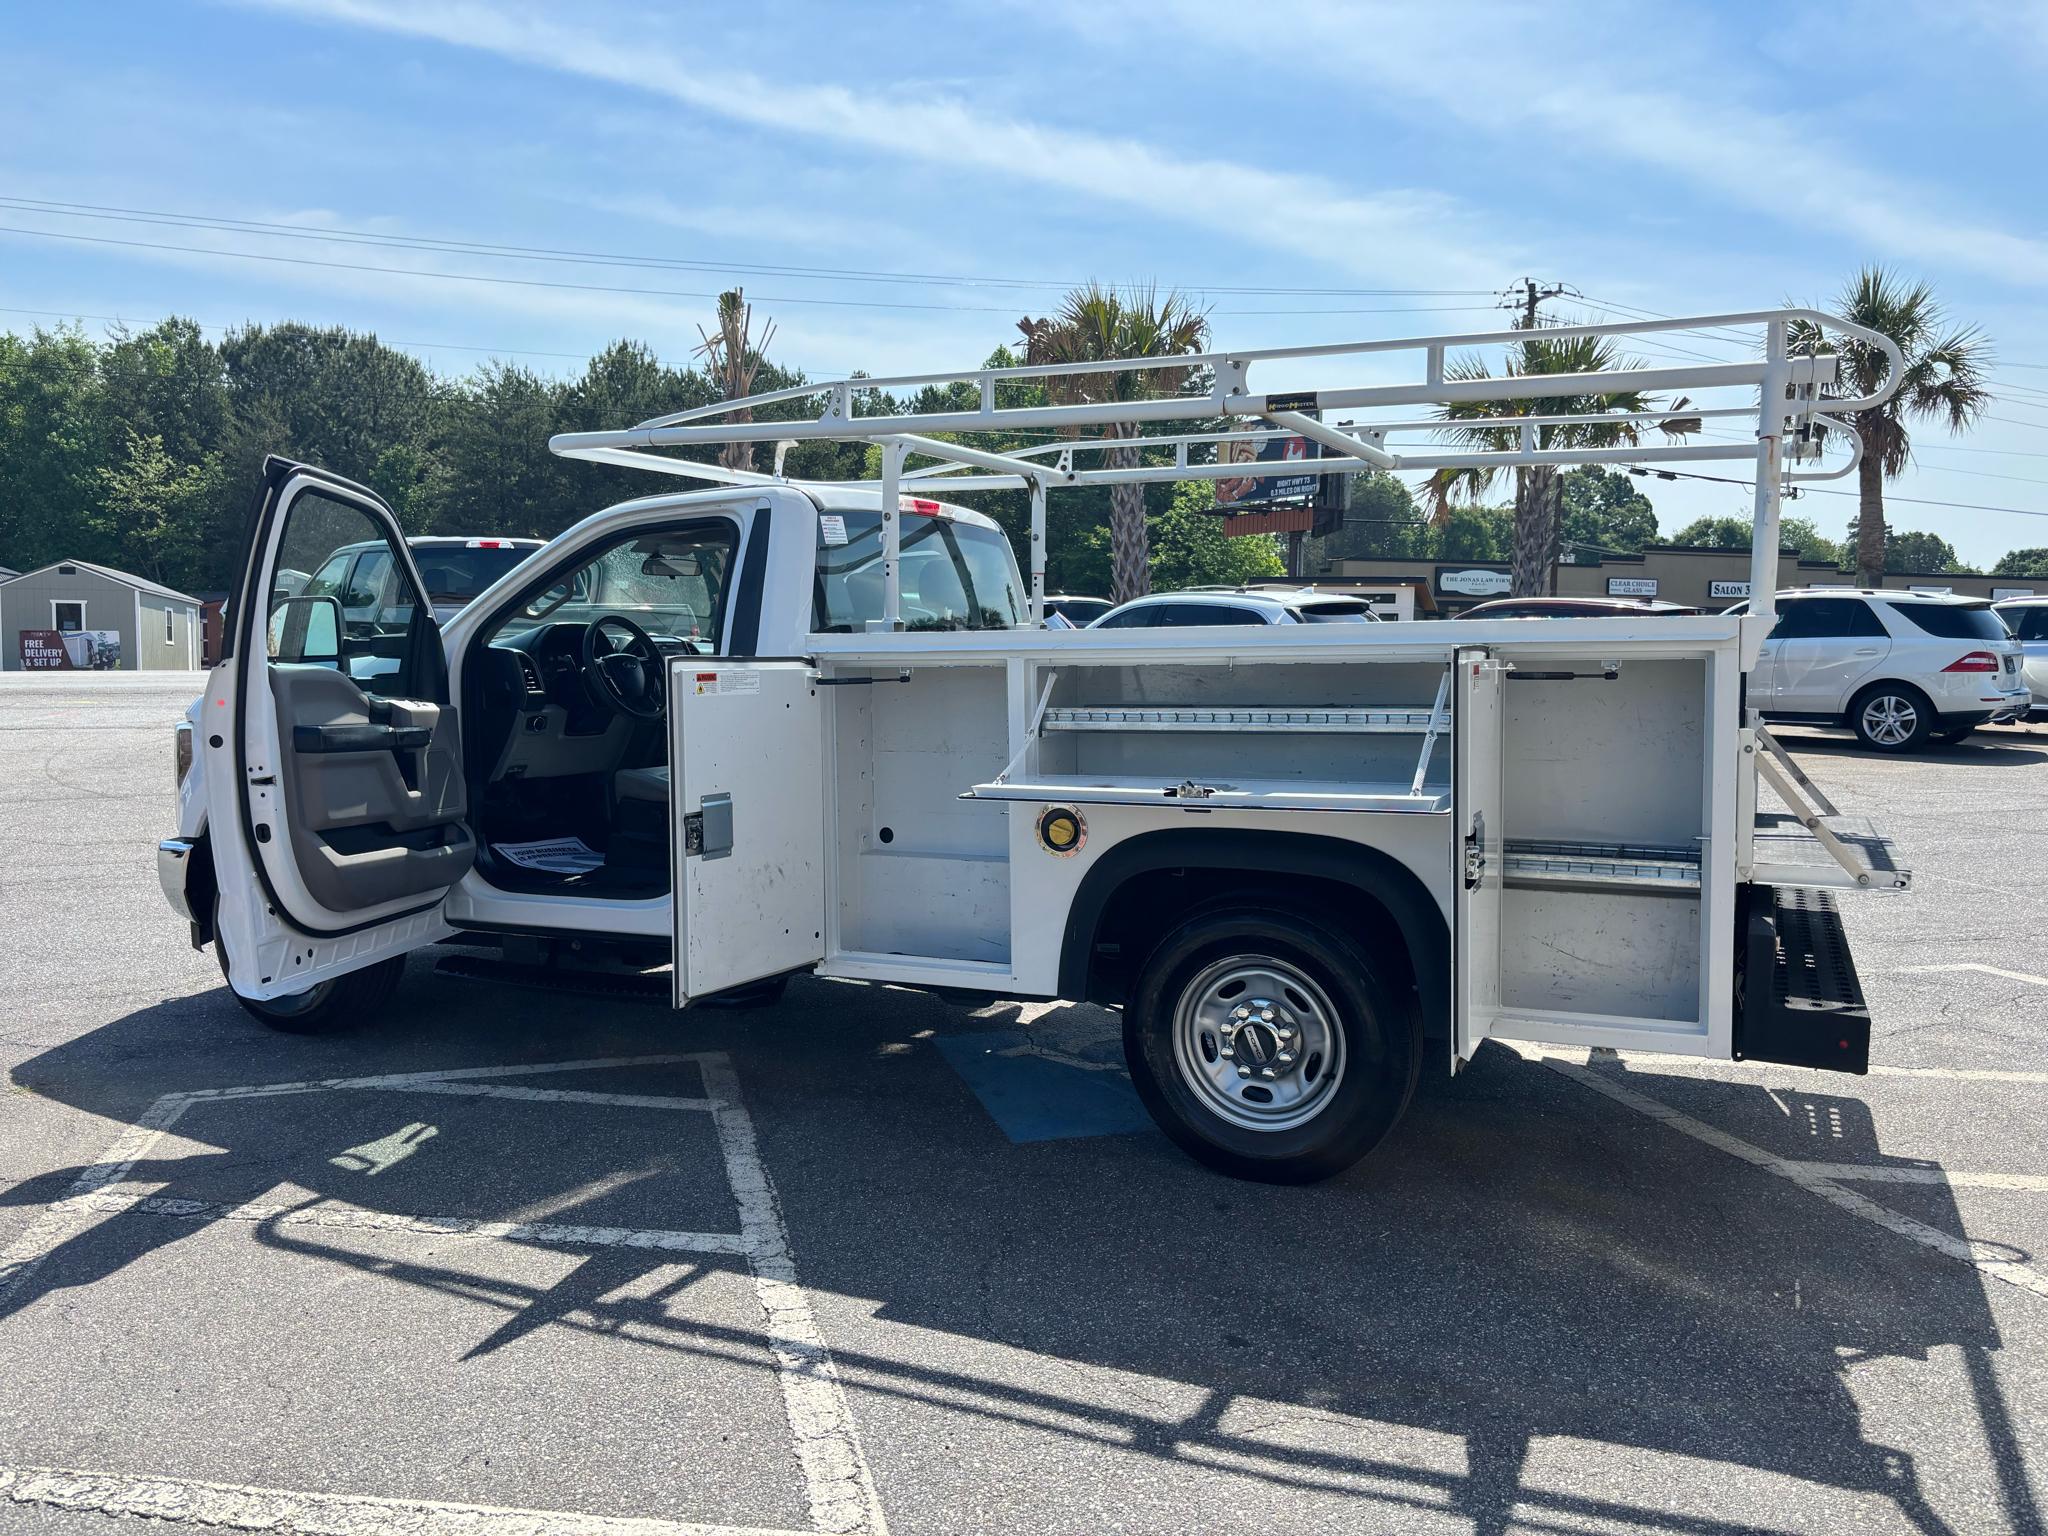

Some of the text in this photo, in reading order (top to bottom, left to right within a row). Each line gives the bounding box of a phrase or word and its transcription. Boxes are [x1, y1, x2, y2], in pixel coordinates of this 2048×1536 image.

[1276, 476, 1310, 488] RIGHT HWY 73
[1278, 487, 1293, 495] MILES
[1301, 484, 1316, 492] RIGHT
[1713, 584, 1743, 595] SALON
[24, 639, 45, 648] FREE
[24, 648, 63, 657] DELIVERY
[25, 658, 62, 667] & SET UP
[1246, 1029, 1263, 1060] FORD
